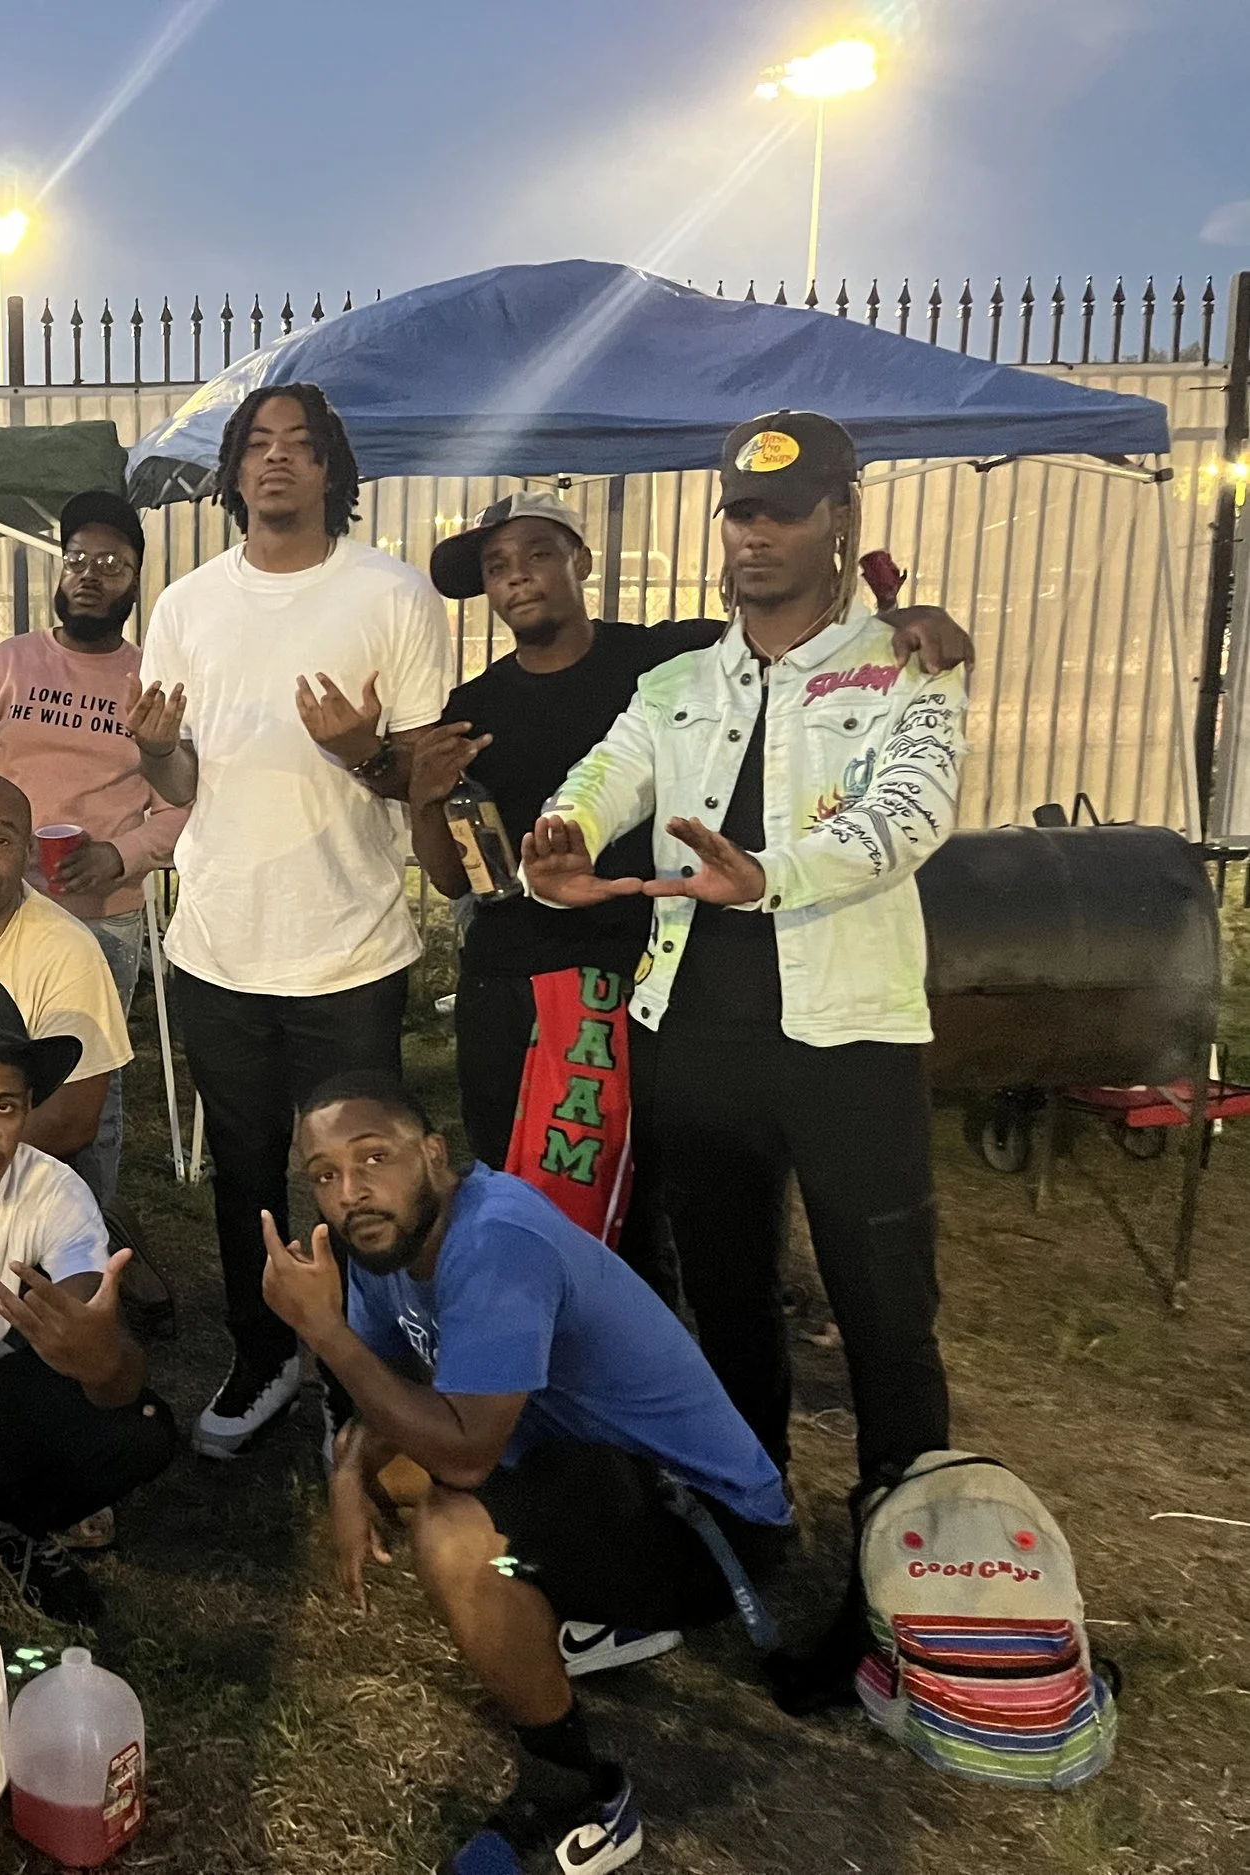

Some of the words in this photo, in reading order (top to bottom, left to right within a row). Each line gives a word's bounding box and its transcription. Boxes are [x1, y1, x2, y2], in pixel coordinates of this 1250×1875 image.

[29, 687, 73, 706] LONG
[80, 695, 117, 715] LIVE
[9, 704, 34, 720] HE
[40, 708, 83, 729] WILD
[539, 966, 622, 1186] UAAM
[908, 1560, 975, 1578] Good
